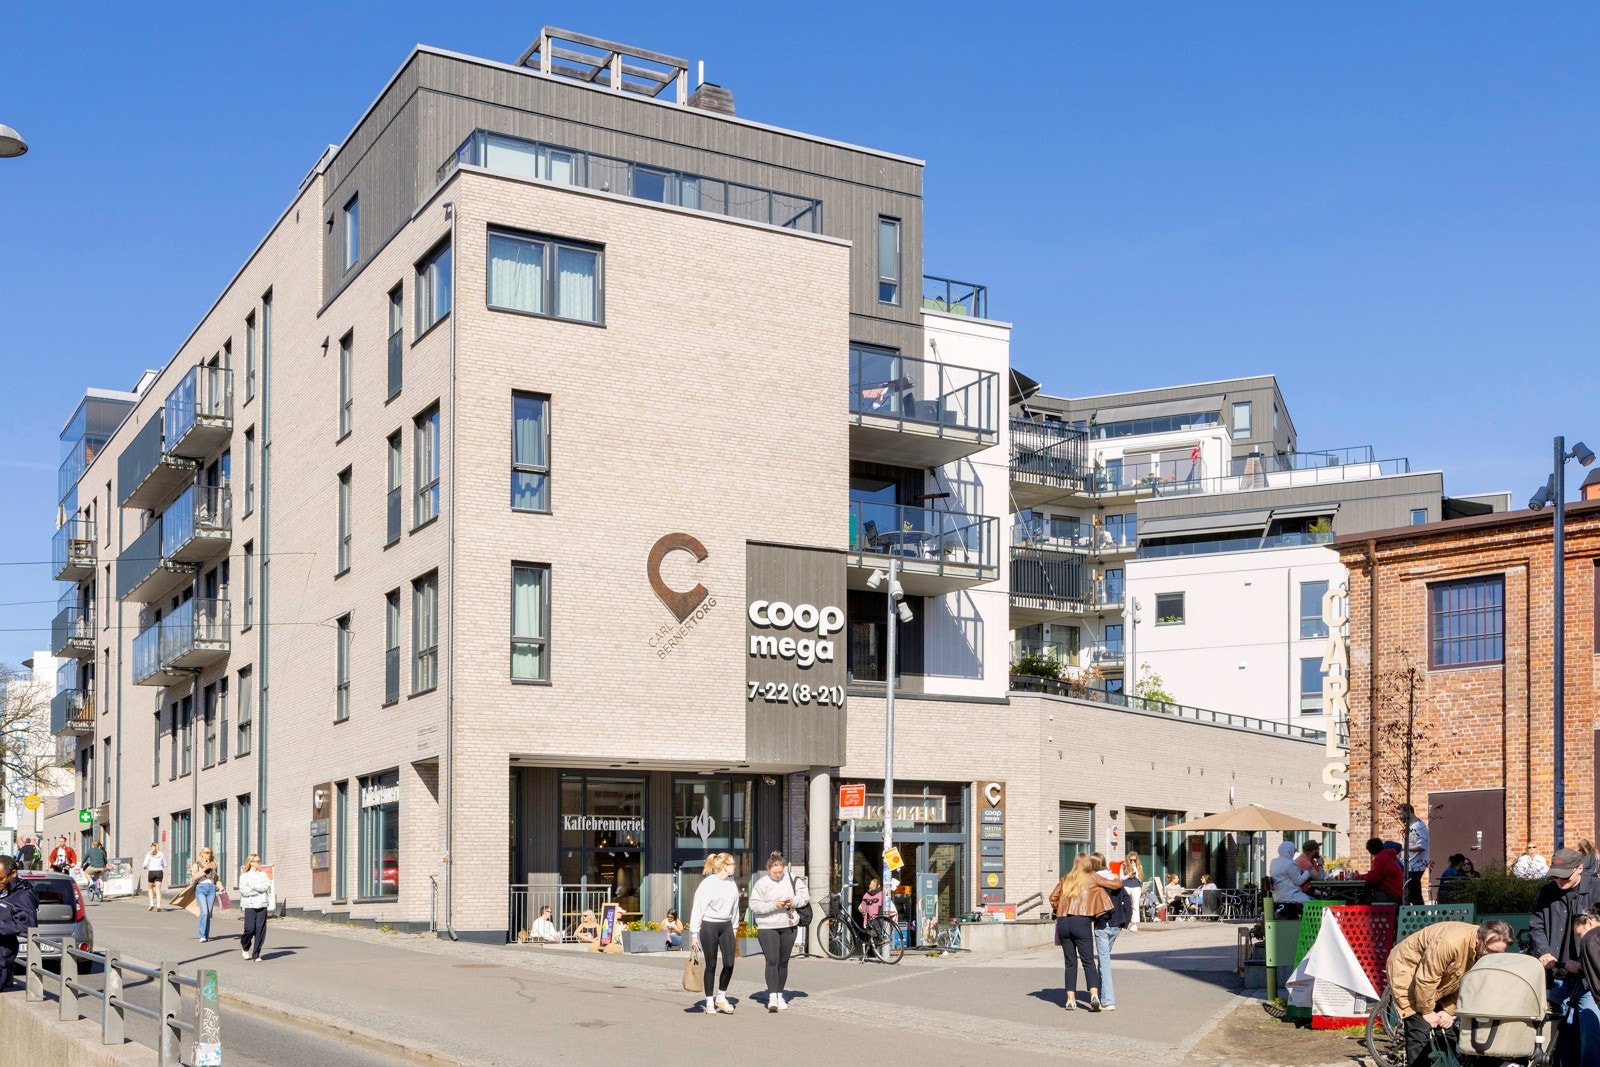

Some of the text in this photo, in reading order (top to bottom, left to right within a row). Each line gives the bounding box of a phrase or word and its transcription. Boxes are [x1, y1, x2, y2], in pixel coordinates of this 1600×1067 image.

[749, 600, 844, 636] coop
[648, 624, 674, 648] CARL
[750, 634, 834, 667] mega
[749, 682, 844, 706] 7-22 (8-21)
[1320, 588, 1349, 802] CARLS
[563, 815, 645, 831] Kaffebrenneriet
